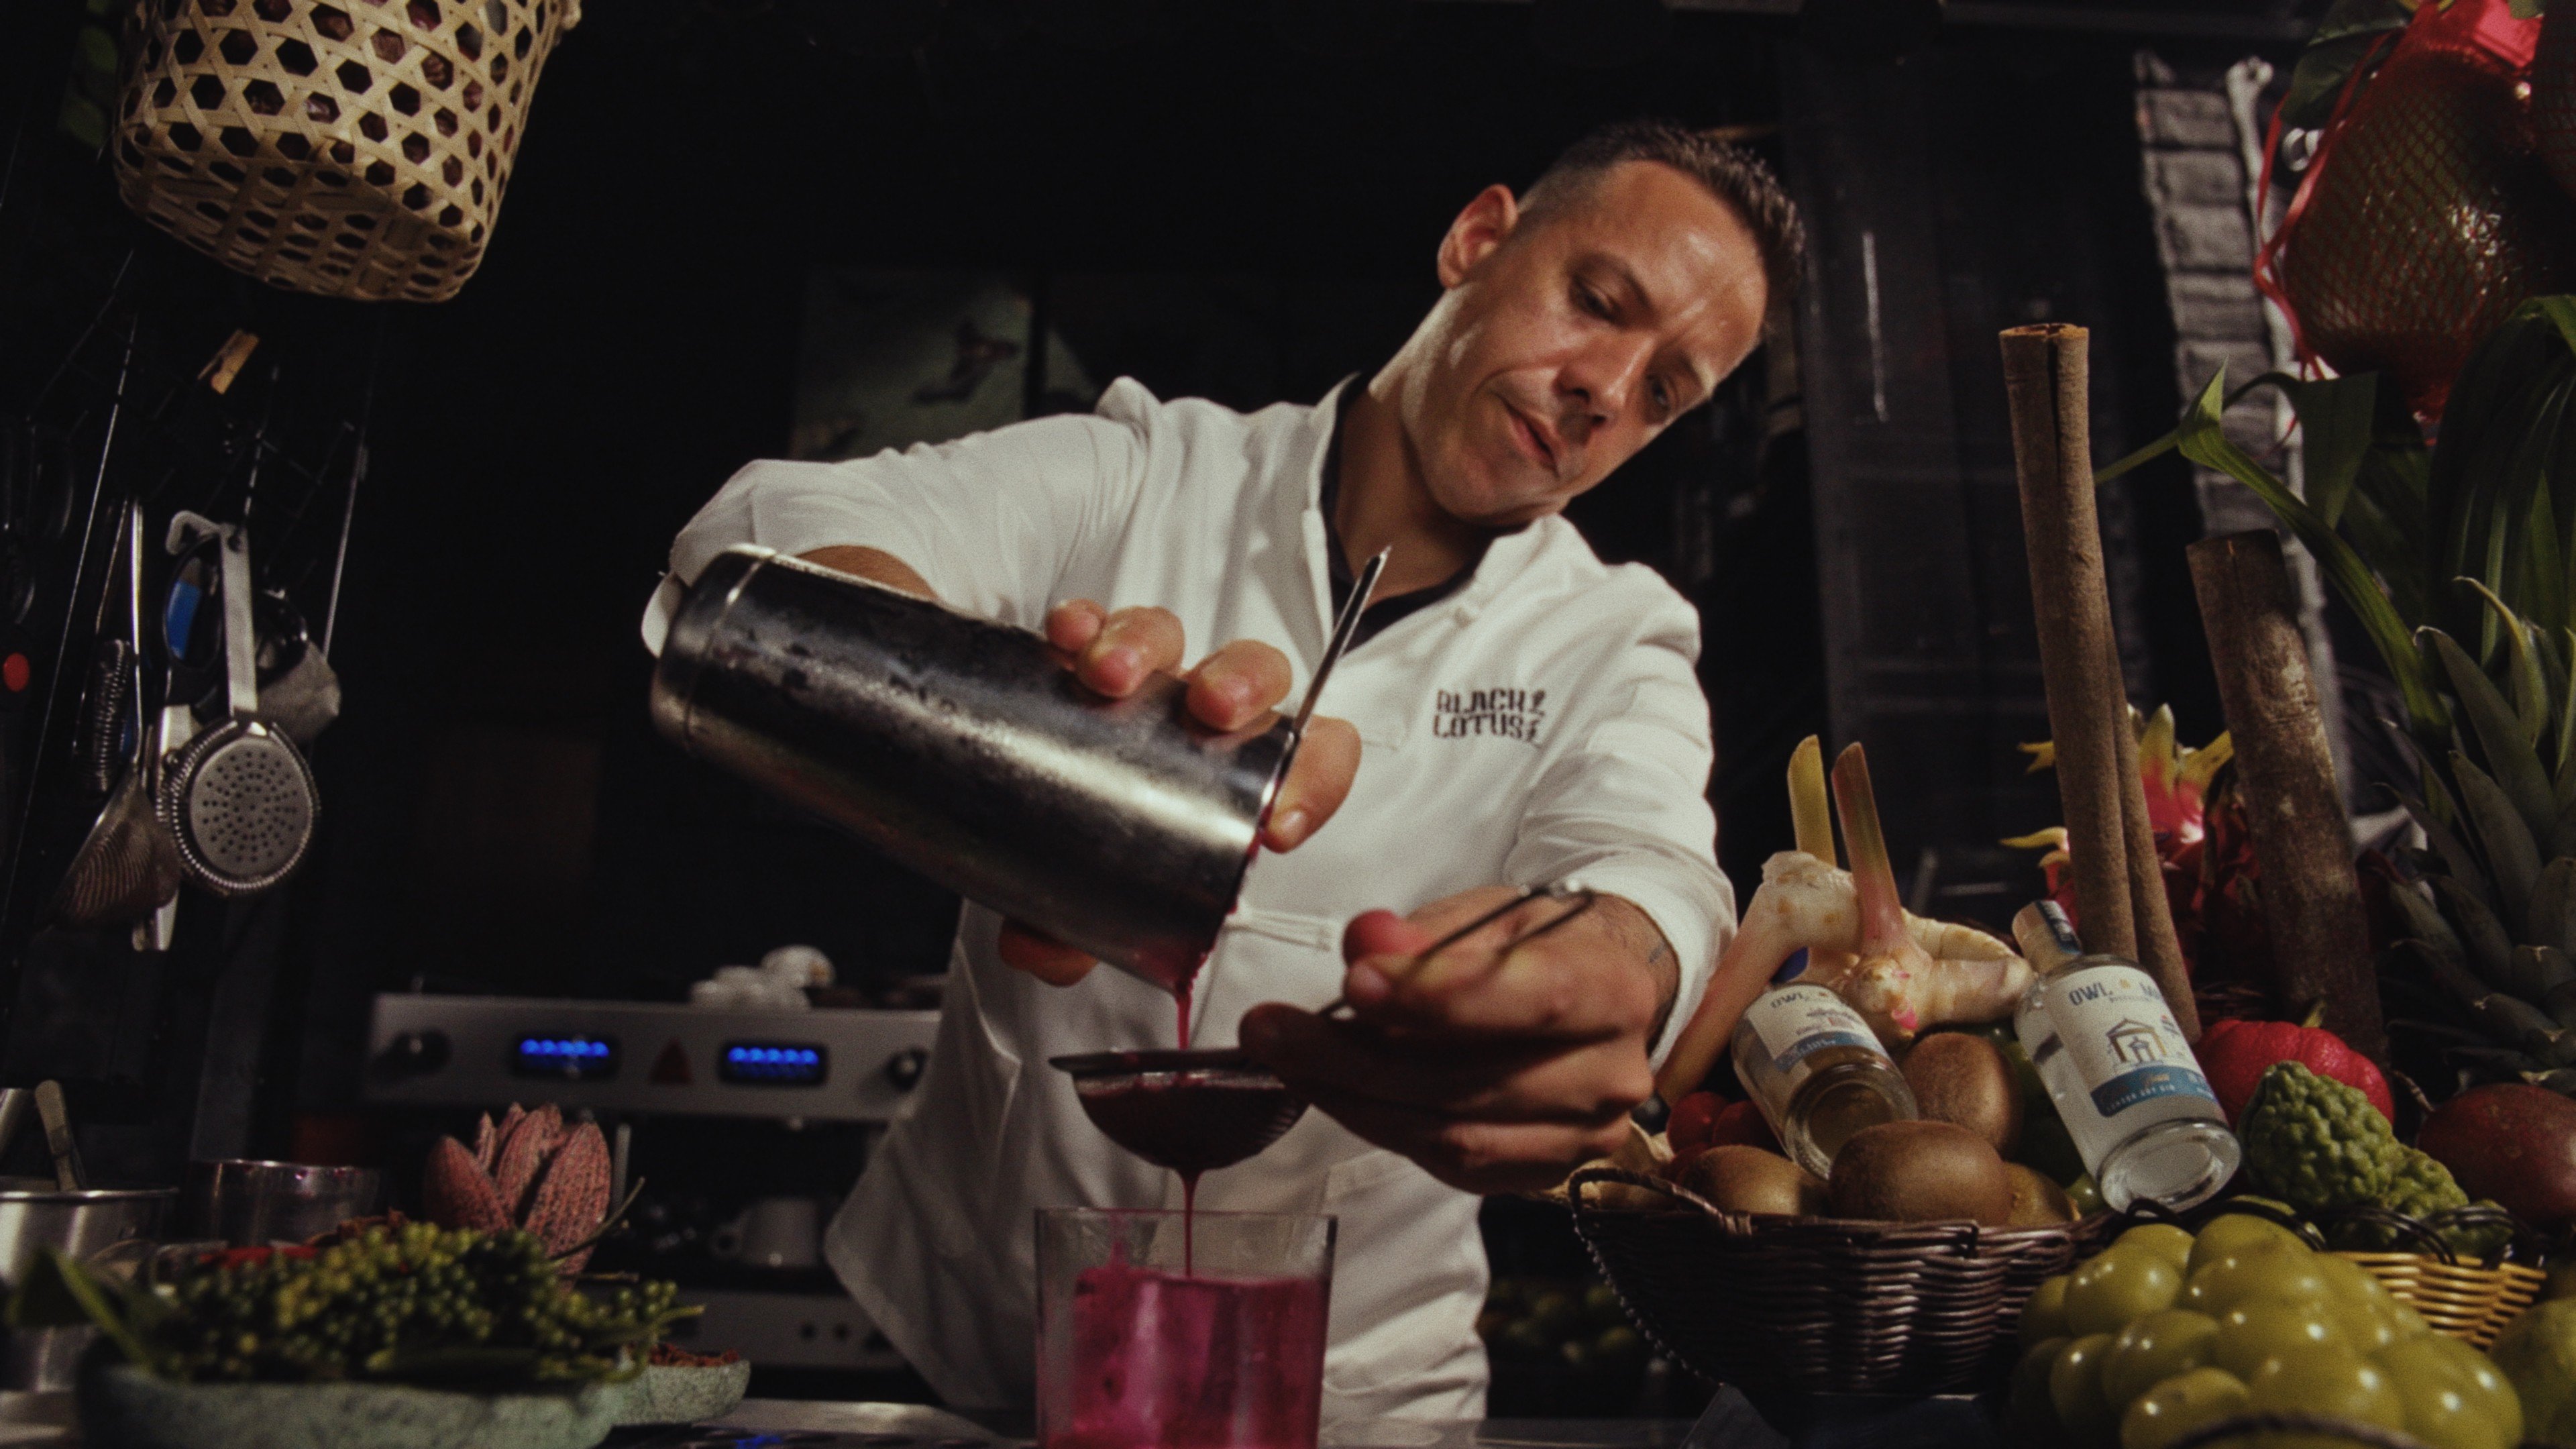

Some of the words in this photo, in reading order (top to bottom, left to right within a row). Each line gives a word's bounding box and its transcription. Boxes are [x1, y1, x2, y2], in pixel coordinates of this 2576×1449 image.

[1432, 712, 1523, 739] LOTUS
[1770, 991, 1810, 1009] OWL
[2068, 981, 2114, 1006] OWL
